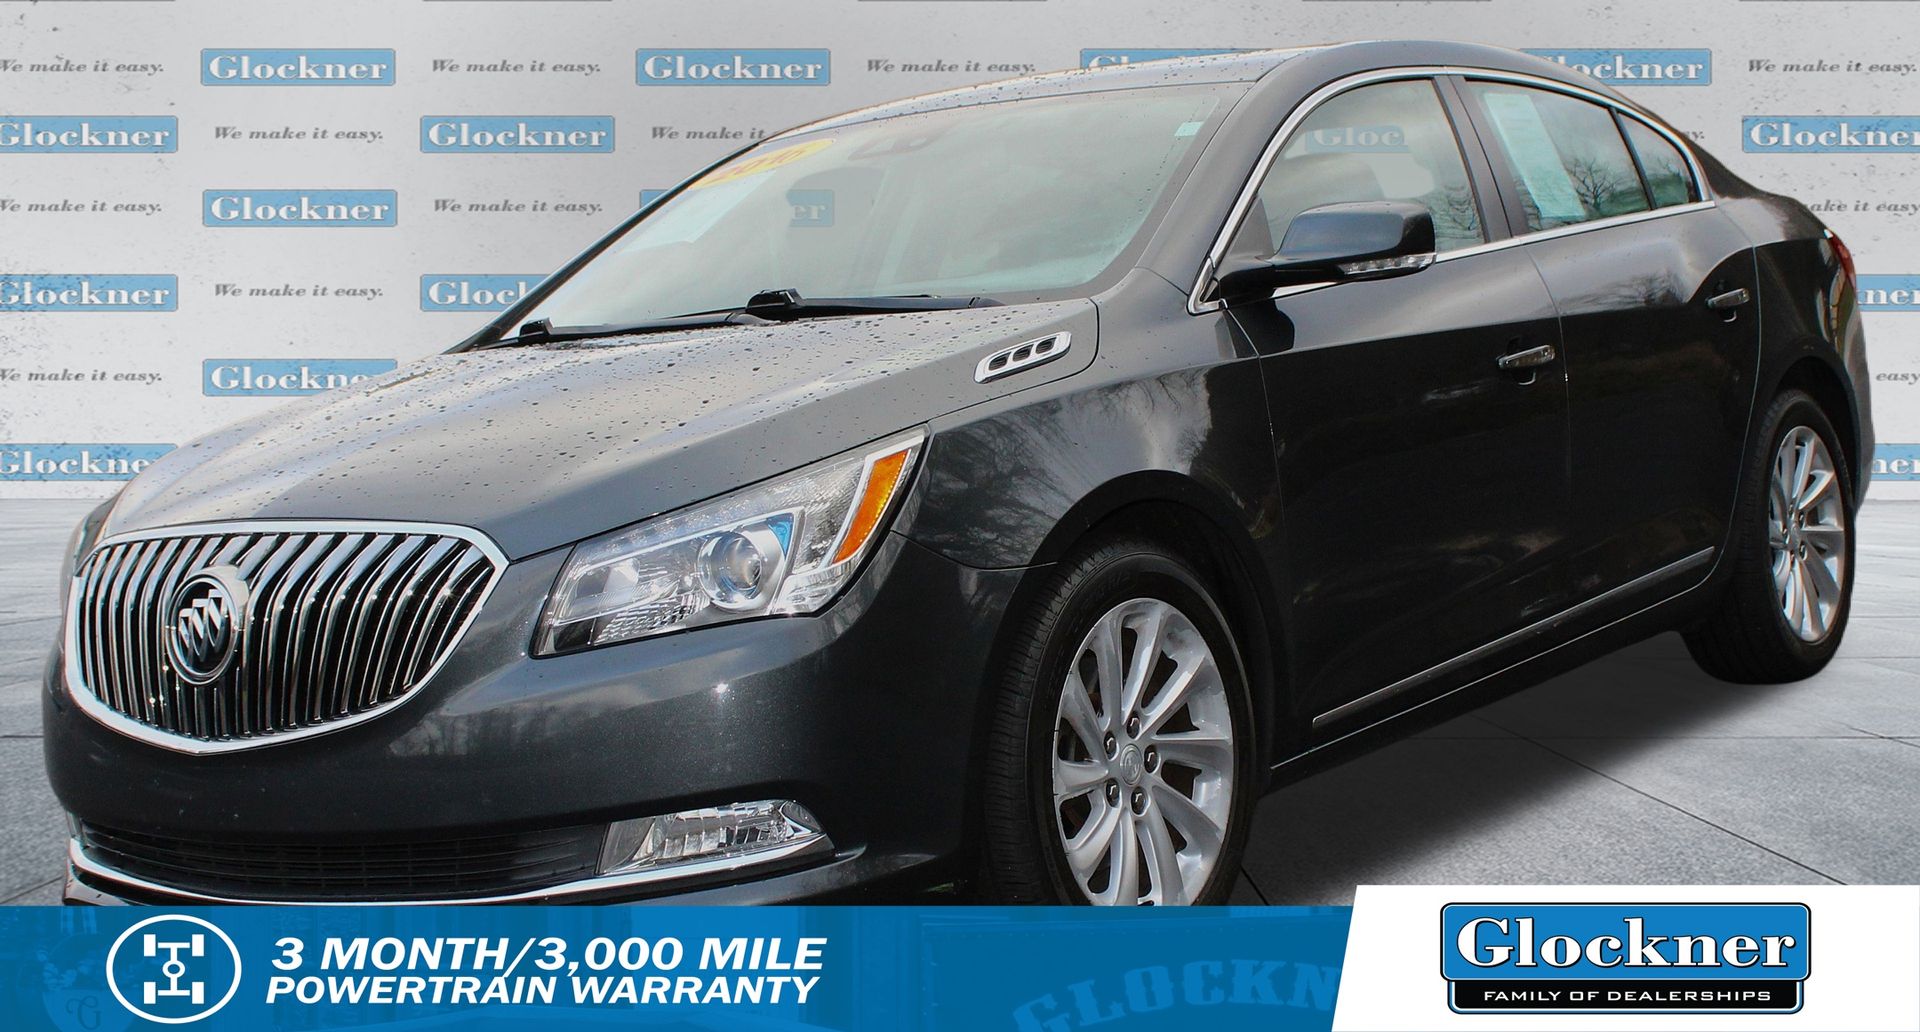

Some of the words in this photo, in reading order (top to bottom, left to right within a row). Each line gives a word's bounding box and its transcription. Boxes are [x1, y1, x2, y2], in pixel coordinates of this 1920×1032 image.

[30, 59, 87, 72] make
[93, 60, 109, 72] it
[115, 63, 164, 76] easy.
[209, 55, 387, 79] Glockner
[432, 59, 460, 72] We
[466, 59, 524, 72] make
[530, 60, 546, 72] it
[552, 63, 601, 76] easy.
[644, 55, 822, 79] Glockner
[867, 59, 895, 72] We
[901, 59, 959, 72] make
[964, 60, 980, 72] it
[986, 63, 1036, 76] easy.
[1749, 59, 1776, 72] We
[1782, 59, 1840, 72] make
[1846, 60, 1862, 72] it
[1868, 63, 1917, 76] easy.
[0, 122, 169, 146] Glockner
[215, 126, 243, 139] We
[249, 126, 307, 139] make
[312, 127, 329, 139] it
[334, 130, 384, 143] easy.
[428, 122, 606, 146] Glockner
[652, 126, 680, 139] We
[686, 126, 744, 139] make
[750, 127, 766, 140] it
[1313, 127, 1408, 147] Gloc
[27, 199, 85, 212] make
[91, 200, 107, 212] it
[113, 203, 162, 216] easy.
[211, 196, 389, 220] Glockner
[434, 199, 462, 212] We
[468, 199, 526, 212] make
[531, 200, 547, 212] it
[553, 203, 603, 216] easy.
[1809, 199, 1848, 212] ake
[1853, 200, 1869, 212] it
[0, 281, 170, 305] Glockner
[214, 283, 243, 296] We
[249, 283, 307, 296] make
[312, 284, 329, 296] it
[334, 288, 384, 301] easy.
[428, 281, 528, 305] Gloc
[27, 368, 86, 381] make
[91, 370, 108, 381] it
[113, 373, 163, 385] easy.
[0, 450, 154, 475] Glockne
